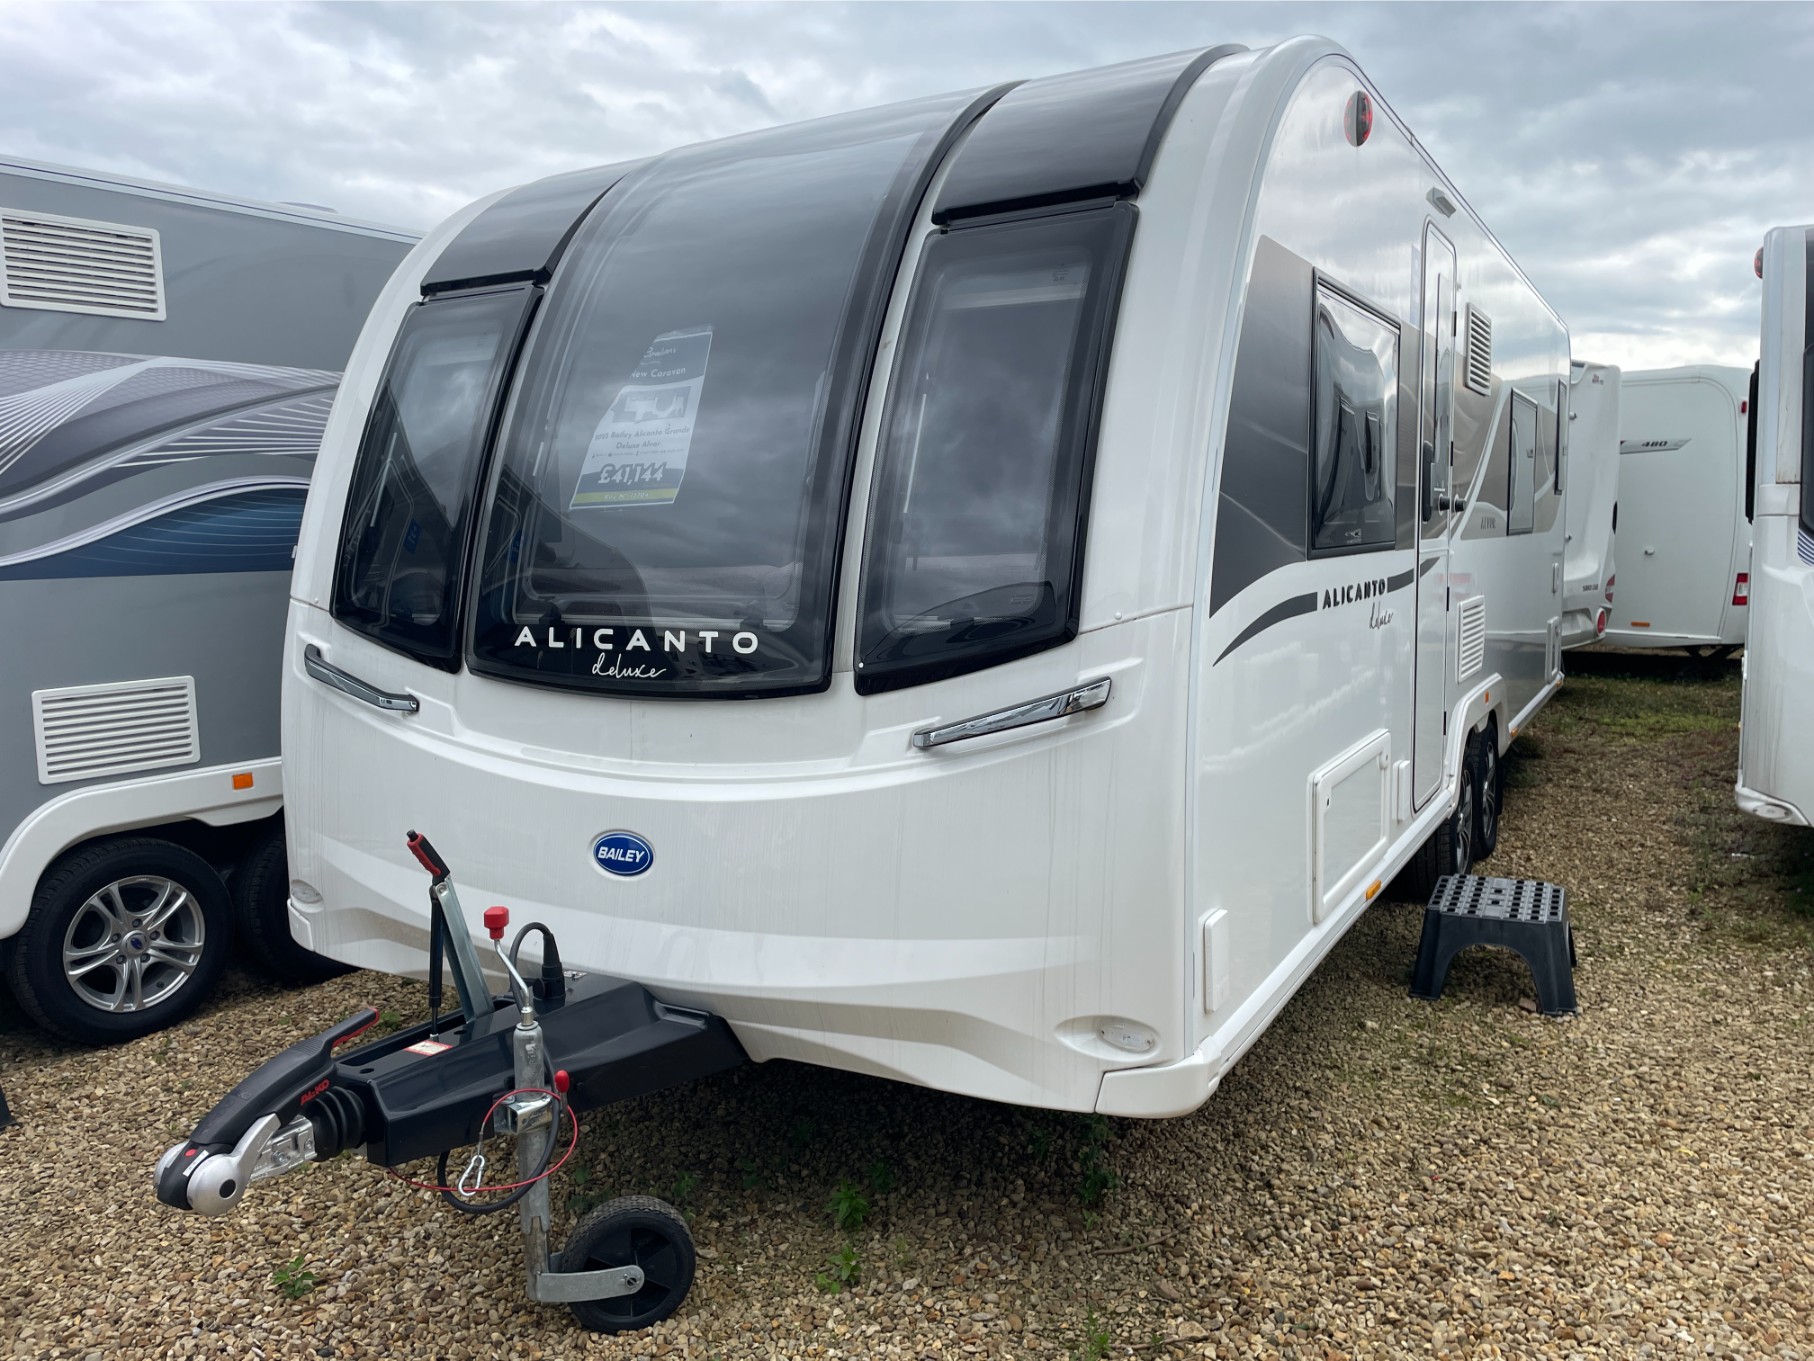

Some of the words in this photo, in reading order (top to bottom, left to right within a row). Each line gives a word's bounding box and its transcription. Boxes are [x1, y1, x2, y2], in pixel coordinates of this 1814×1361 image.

[651, 367, 687, 378] Caravan
[611, 430, 633, 439] Bailey
[634, 429, 663, 438] Alicanto
[664, 426, 690, 435] Grande
[616, 441, 641, 449] Deluxe
[598, 463, 667, 486] £41,144
[1322, 578, 1387, 610] ALICANTO
[514, 626, 759, 654] ALICANTO
[592, 652, 667, 679] deluxe
[598, 846, 645, 863] BAILEY
